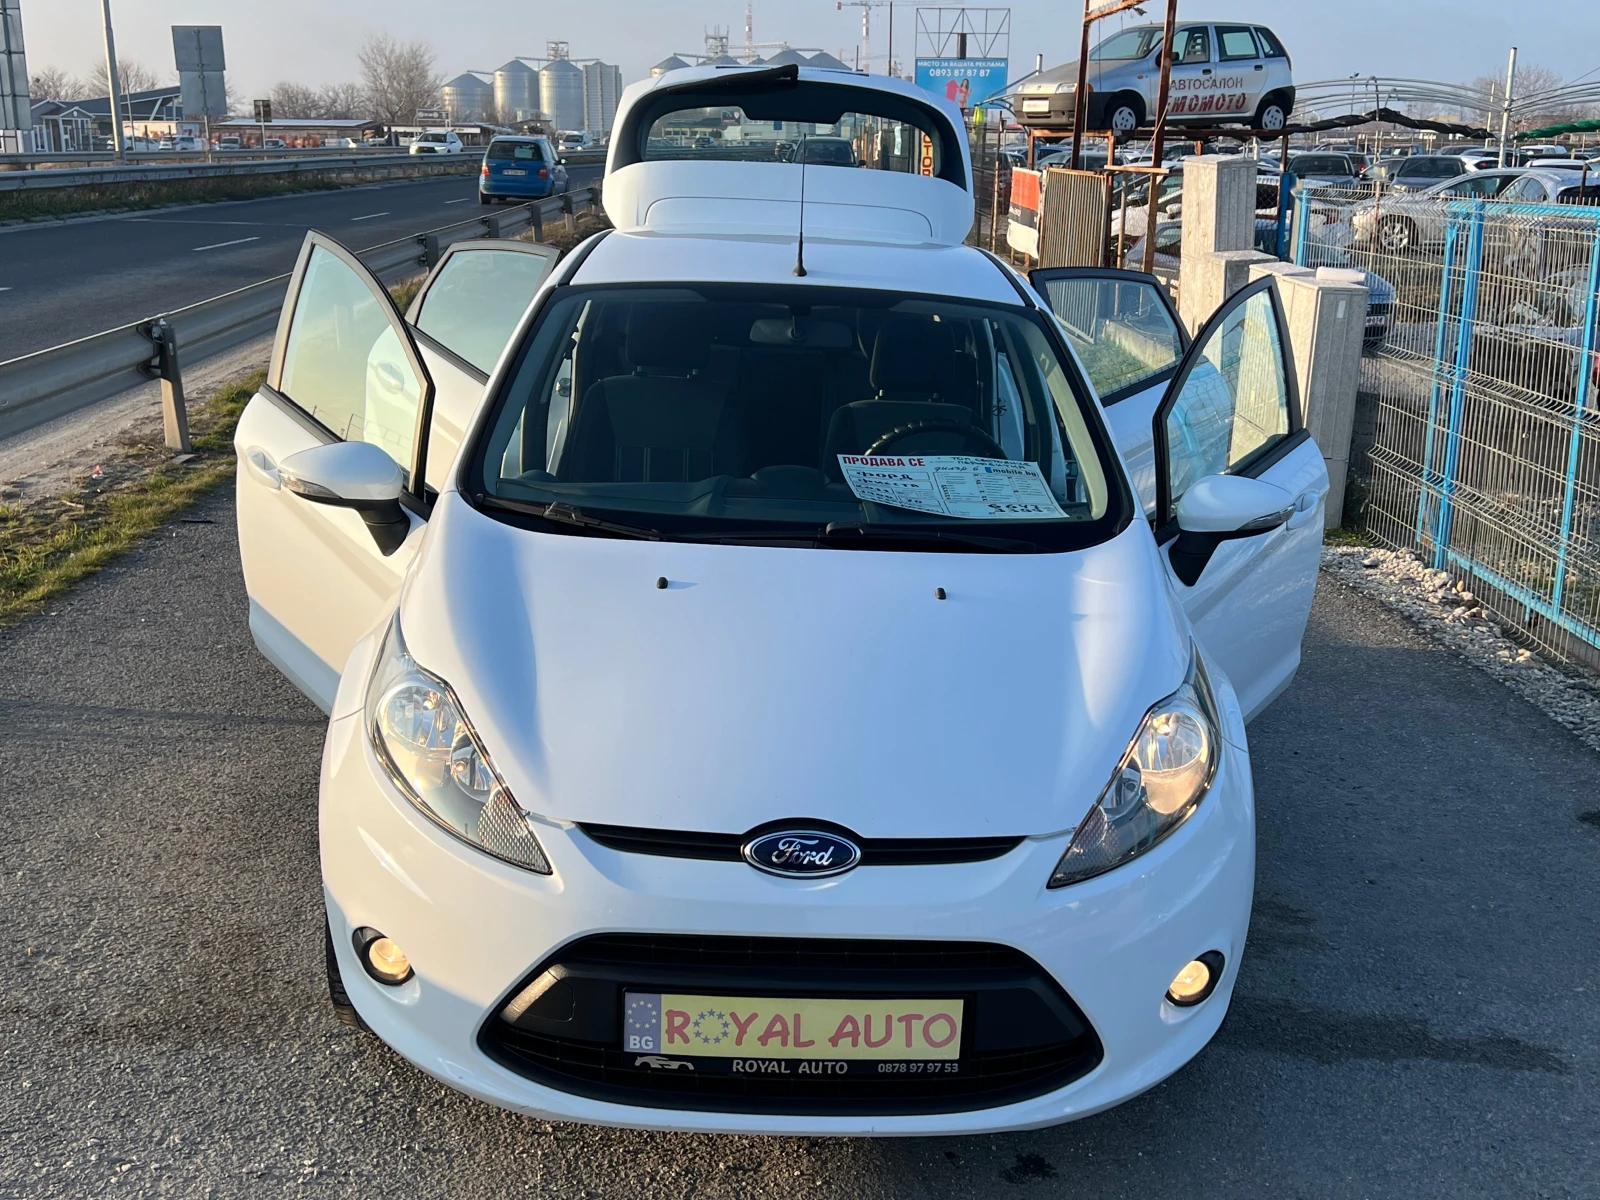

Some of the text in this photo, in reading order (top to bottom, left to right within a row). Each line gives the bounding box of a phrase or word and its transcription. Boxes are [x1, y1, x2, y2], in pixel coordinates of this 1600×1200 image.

[929, 69, 991, 77] 0893 87 87 87
[1169, 77, 1243, 91] АВТОСАЛОН
[842, 456, 926, 467] ПРОДАВА СЕ
[771, 837, 835, 866] Ford
[828, 1013, 958, 1049] AUTO
[629, 1035, 654, 1050] BG
[732, 1059, 849, 1075] ROYAL AUTO
[877, 1063, 959, 1073] 0878 97 97 53
